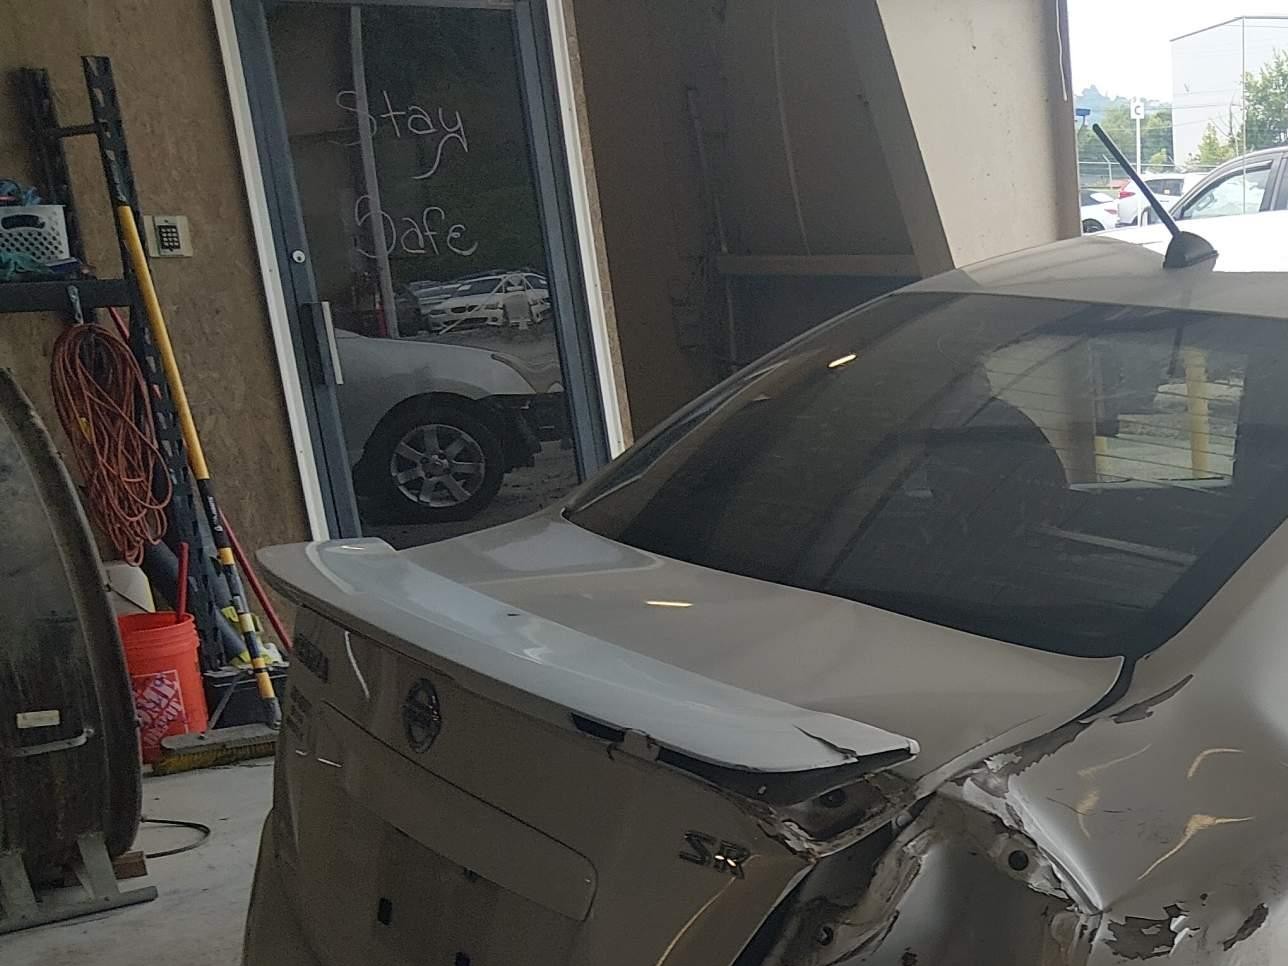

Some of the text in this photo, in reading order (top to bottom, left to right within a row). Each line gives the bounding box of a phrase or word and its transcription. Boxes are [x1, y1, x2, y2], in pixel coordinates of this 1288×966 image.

[329, 89, 469, 180] Stay
[1133, 104, 1142, 116] C
[354, 194, 478, 259] Safe
[679, 830, 751, 880] SR
